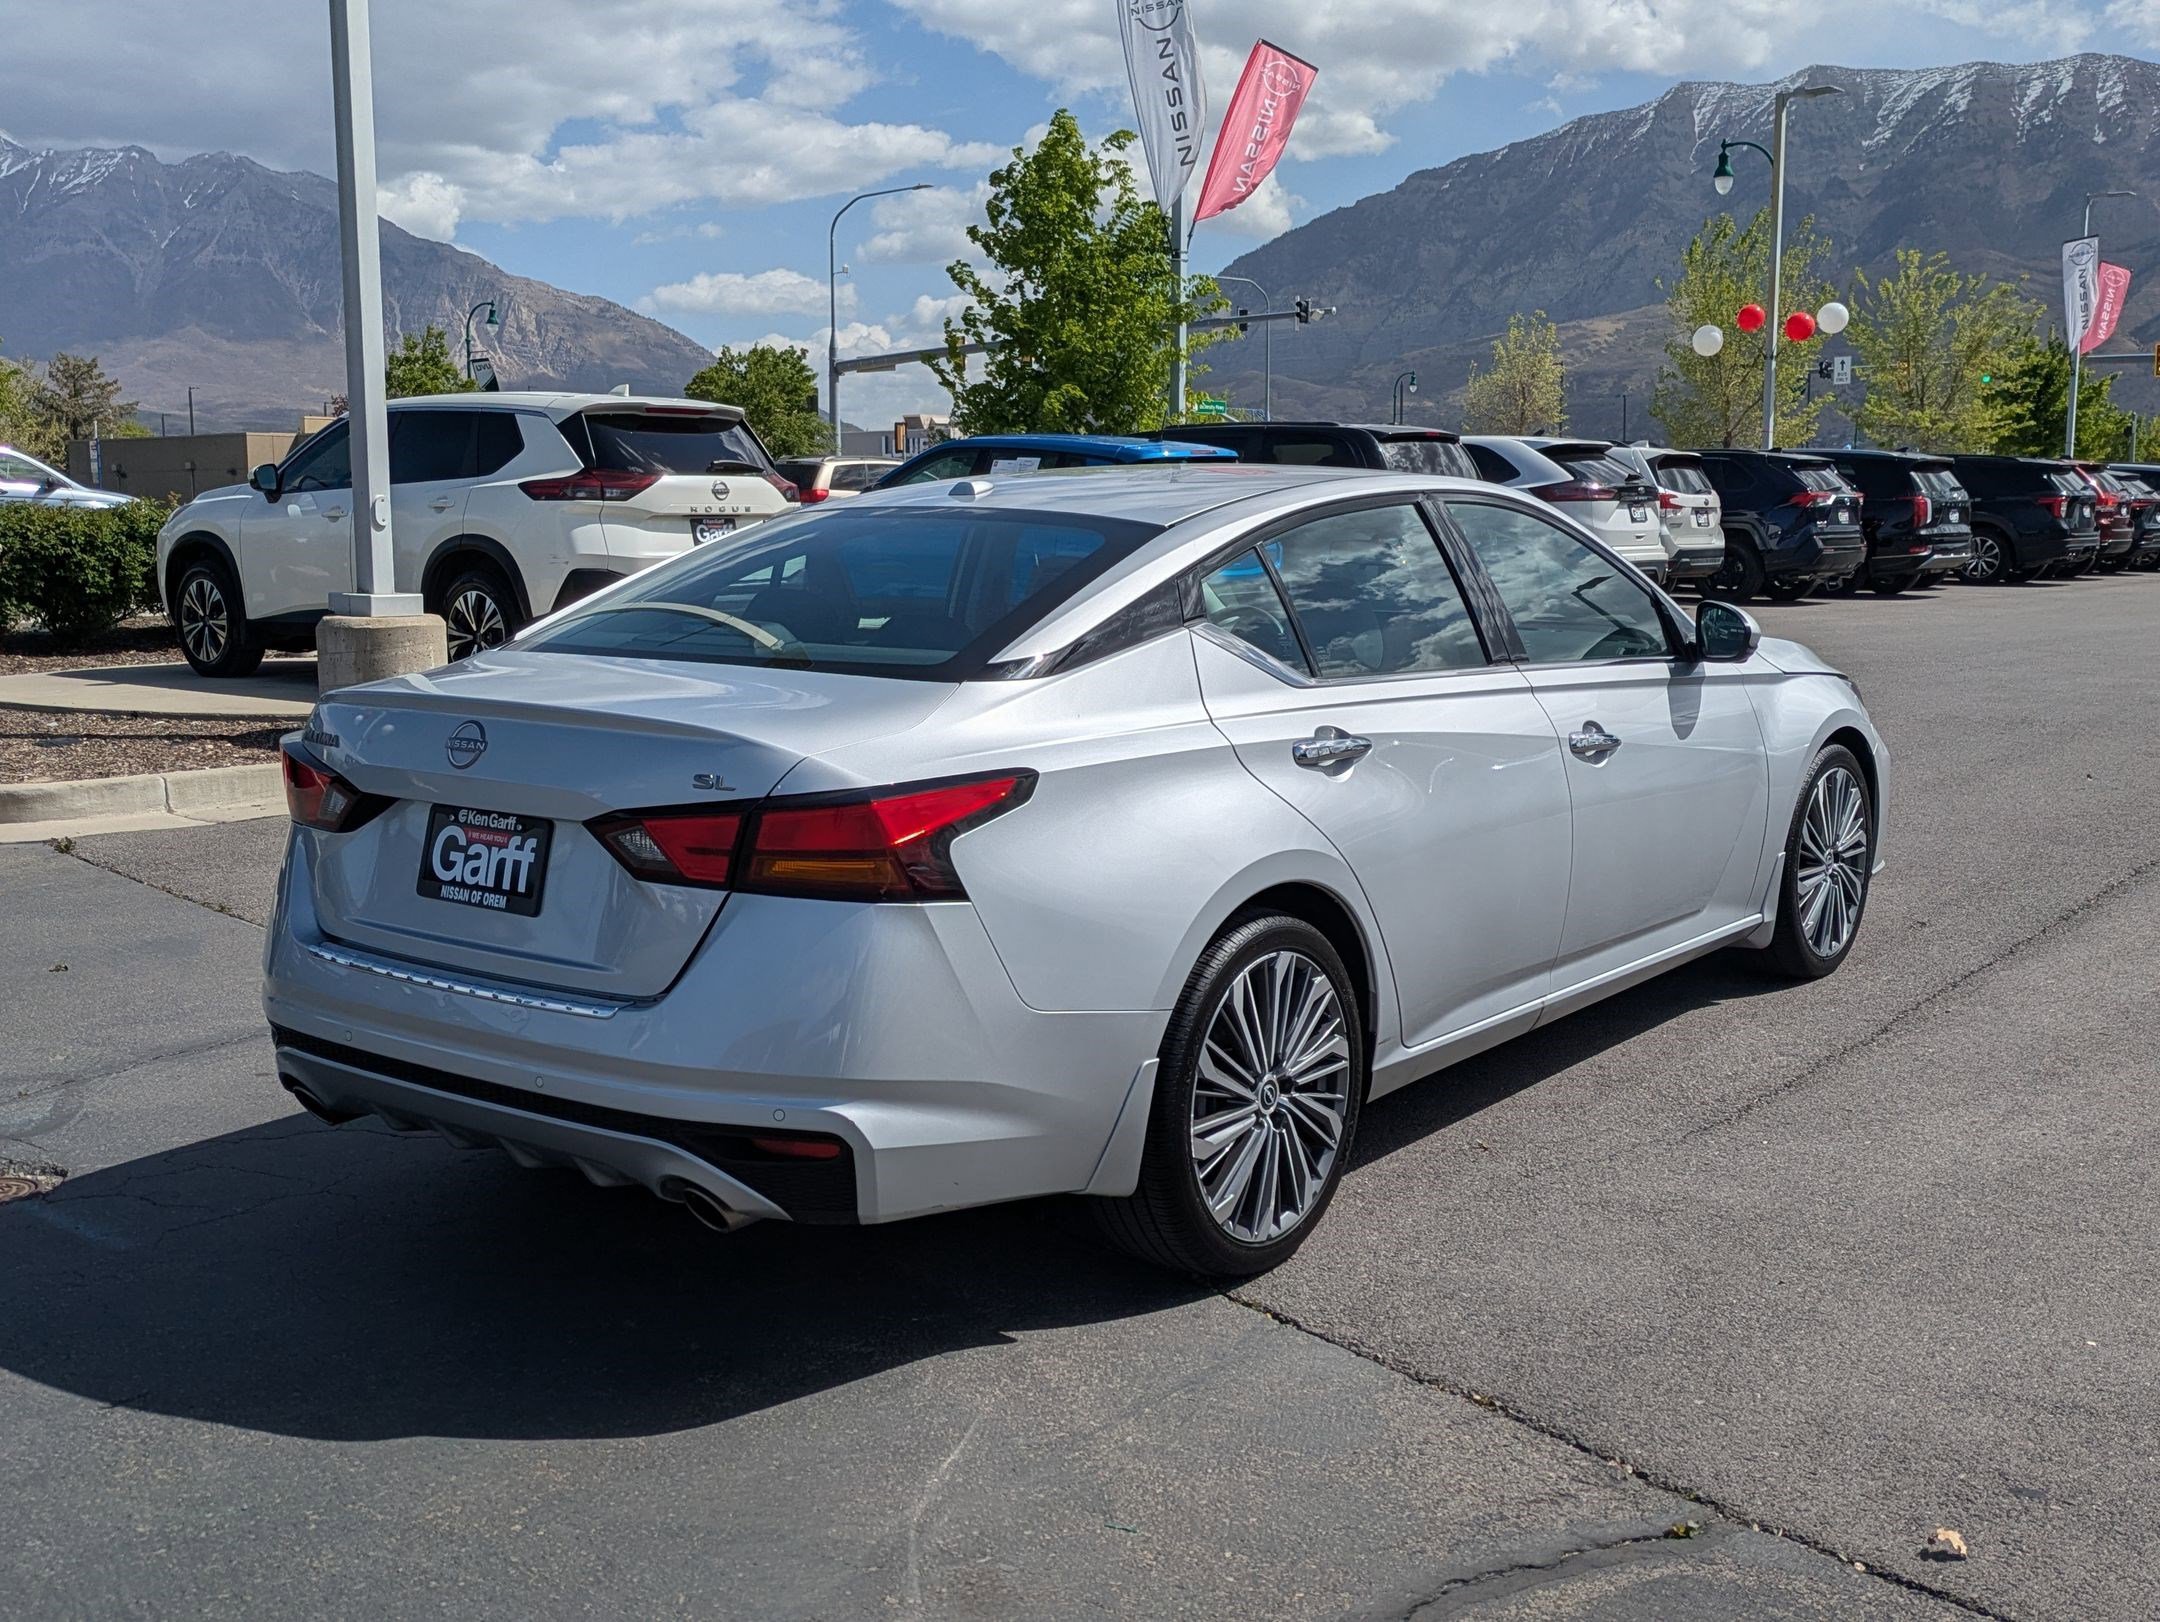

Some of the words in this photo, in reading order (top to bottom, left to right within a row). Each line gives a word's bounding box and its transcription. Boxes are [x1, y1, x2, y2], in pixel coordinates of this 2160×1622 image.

[1130, 0, 1184, 17] NISSAN
[1156, 37, 1195, 167] NISSAN
[2079, 268, 2089, 330] NISSAN
[448, 738, 486, 750] NISSAN
[692, 773, 736, 791] SL
[467, 810, 489, 827] Ken
[489, 813, 517, 831] Garff
[481, 833, 494, 842] HEAR
[432, 825, 538, 893] Garff
[440, 885, 470, 902] NISSAN
[470, 891, 482, 904] OF
[483, 892, 507, 909] OREM
